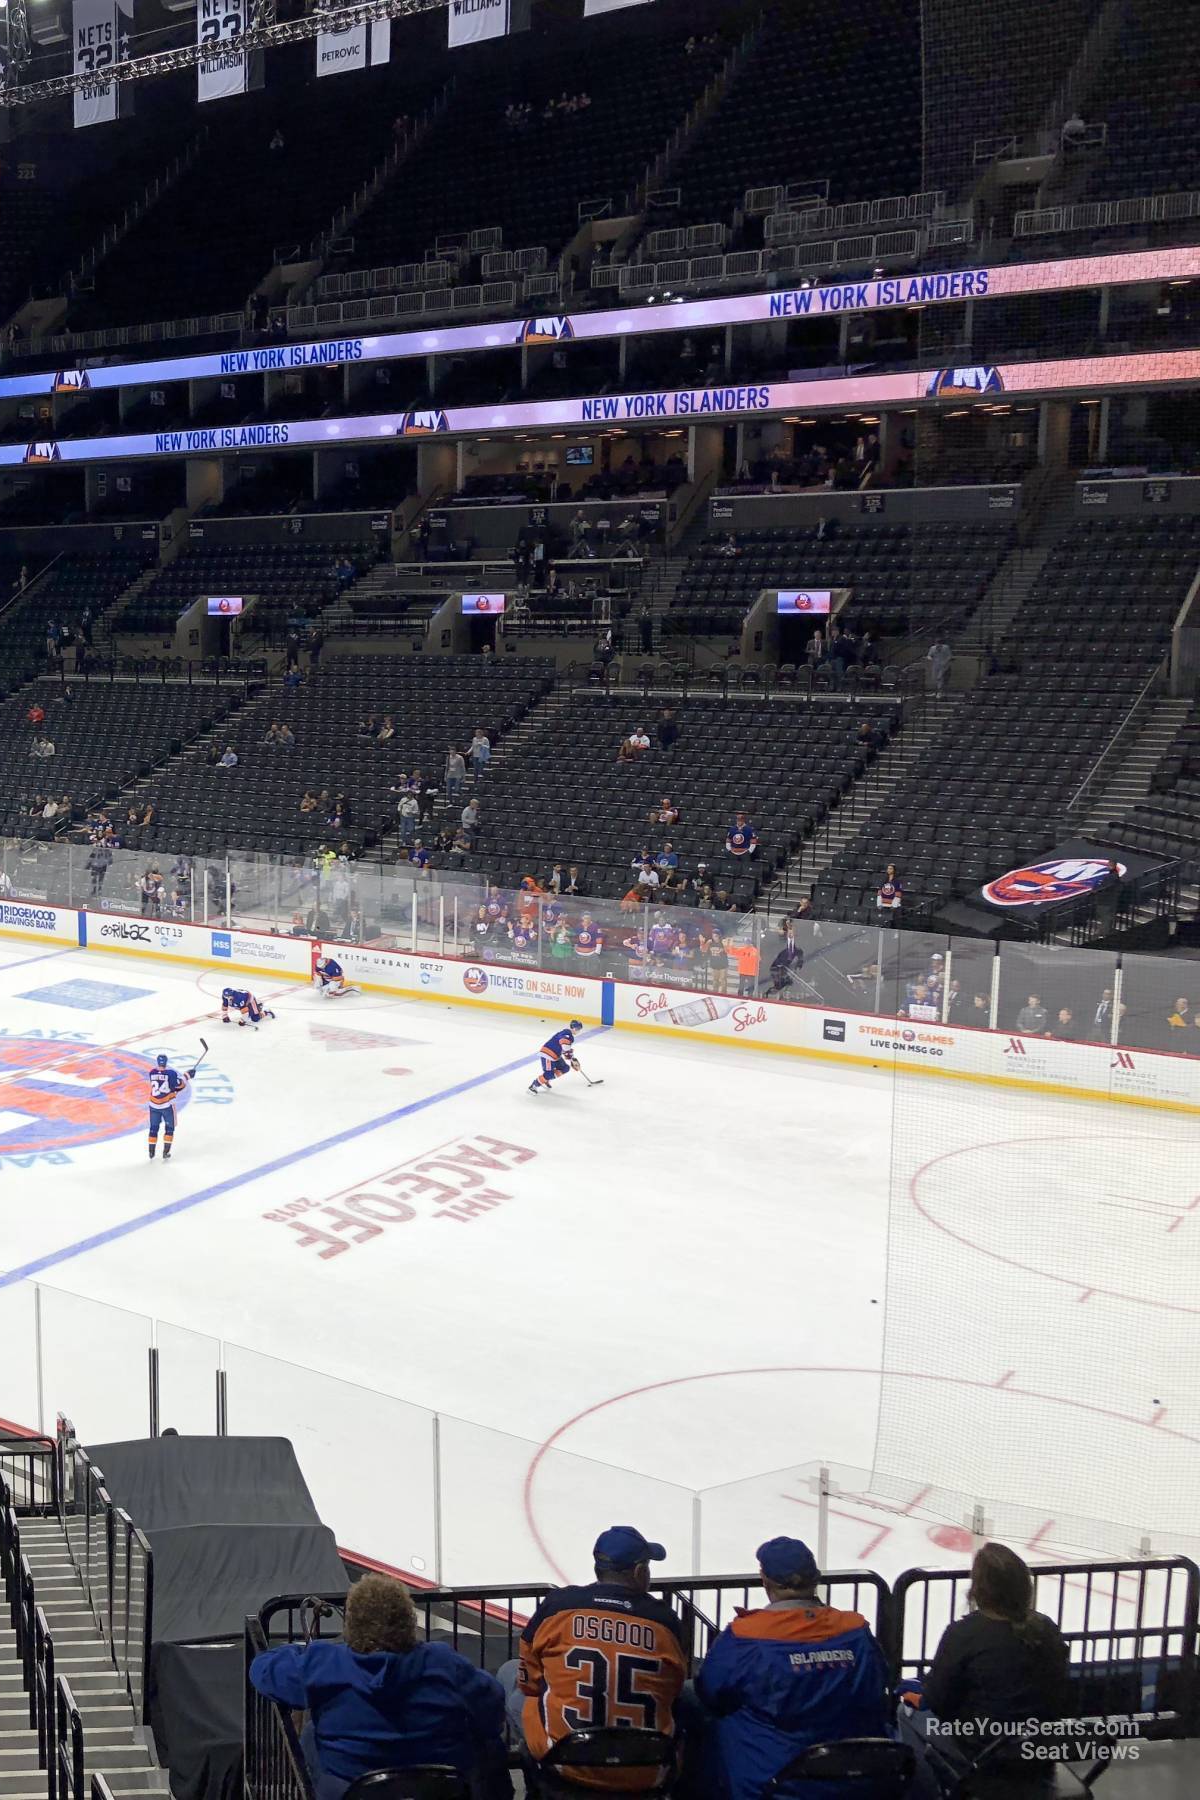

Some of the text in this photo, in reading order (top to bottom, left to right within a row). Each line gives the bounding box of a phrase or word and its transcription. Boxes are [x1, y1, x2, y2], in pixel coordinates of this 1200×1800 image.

[78, 22, 112, 47] NETS
[321, 45, 361, 62] PETROVIC
[200, 53, 243, 75] WILLIAMSON
[83, 84, 111, 100] ERVING
[770, 271, 989, 317] NEW YORK ISLANDERS
[221, 340, 363, 373] NEW YORK ISLANDERS
[582, 387, 770, 420] NEW YORK ISLANDERS
[155, 425, 289, 452] NEW YORK ISLANDERS
[3, 905, 57, 922] RIDGEWOOD
[4, 917, 57, 931] SAVINGS BANK
[154, 925, 183, 938] OCT 13
[212, 939, 230, 951] HSS
[234, 941, 262, 950] HOSPITAL
[234, 948, 286, 961] SPECIAL SURGERY
[338, 953, 411, 968] KEITH URBAN
[420, 962, 444, 972] OCT 27
[490, 973, 585, 998] TICKETS ON SALE NOW
[636, 992, 670, 1018] Stoli
[732, 1006, 768, 1032] Stoli
[858, 1025, 901, 1038] STREAM
[918, 1033, 955, 1046] GAMES
[870, 1039, 943, 1057] LIVE ON MSG GO
[151, 1081, 171, 1096] 24
[431, 1188, 514, 1223] NHL
[573, 1615, 657, 1651] OSGOOD
[789, 1650, 855, 1666] ISLANDERS
[562, 1646, 663, 1731] 35
